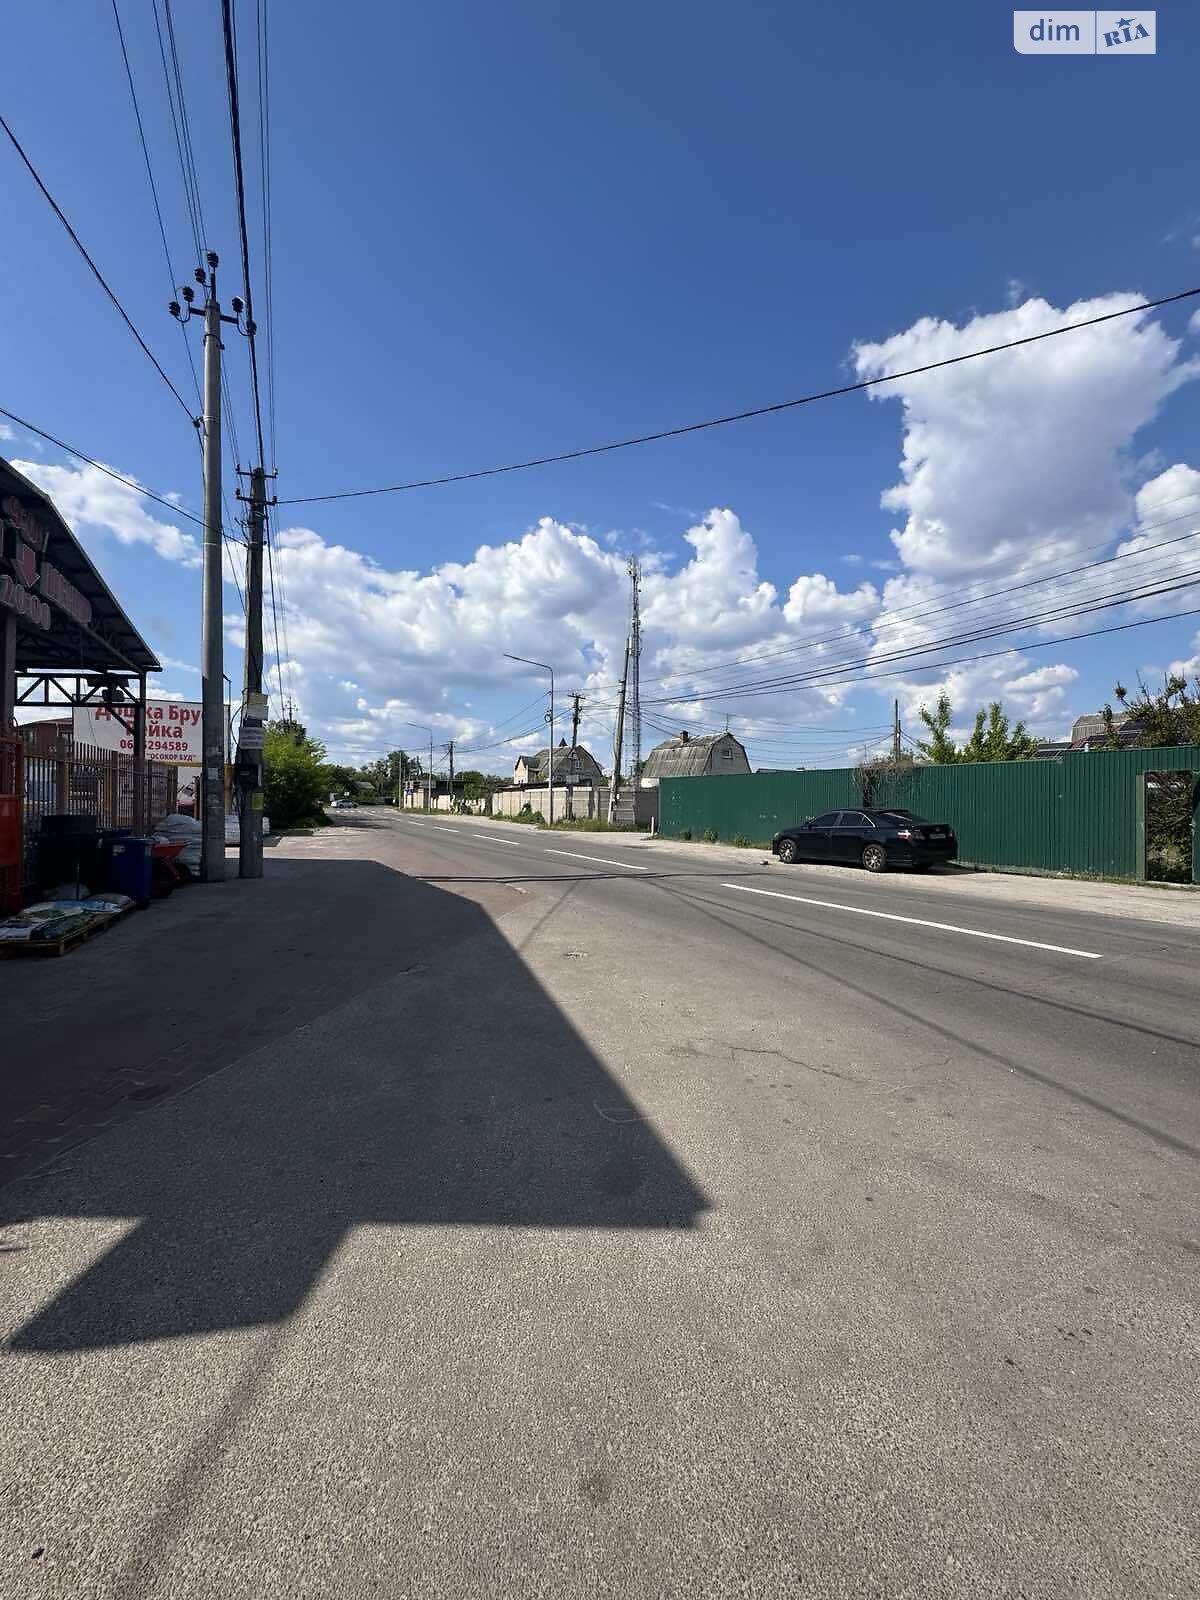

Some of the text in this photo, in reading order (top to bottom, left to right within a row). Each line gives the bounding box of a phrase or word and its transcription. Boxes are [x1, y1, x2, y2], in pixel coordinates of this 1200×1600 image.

[168, 704, 202, 726] Бру
[125, 719, 183, 738] Рйка
[120, 739, 188, 751] 06294589
